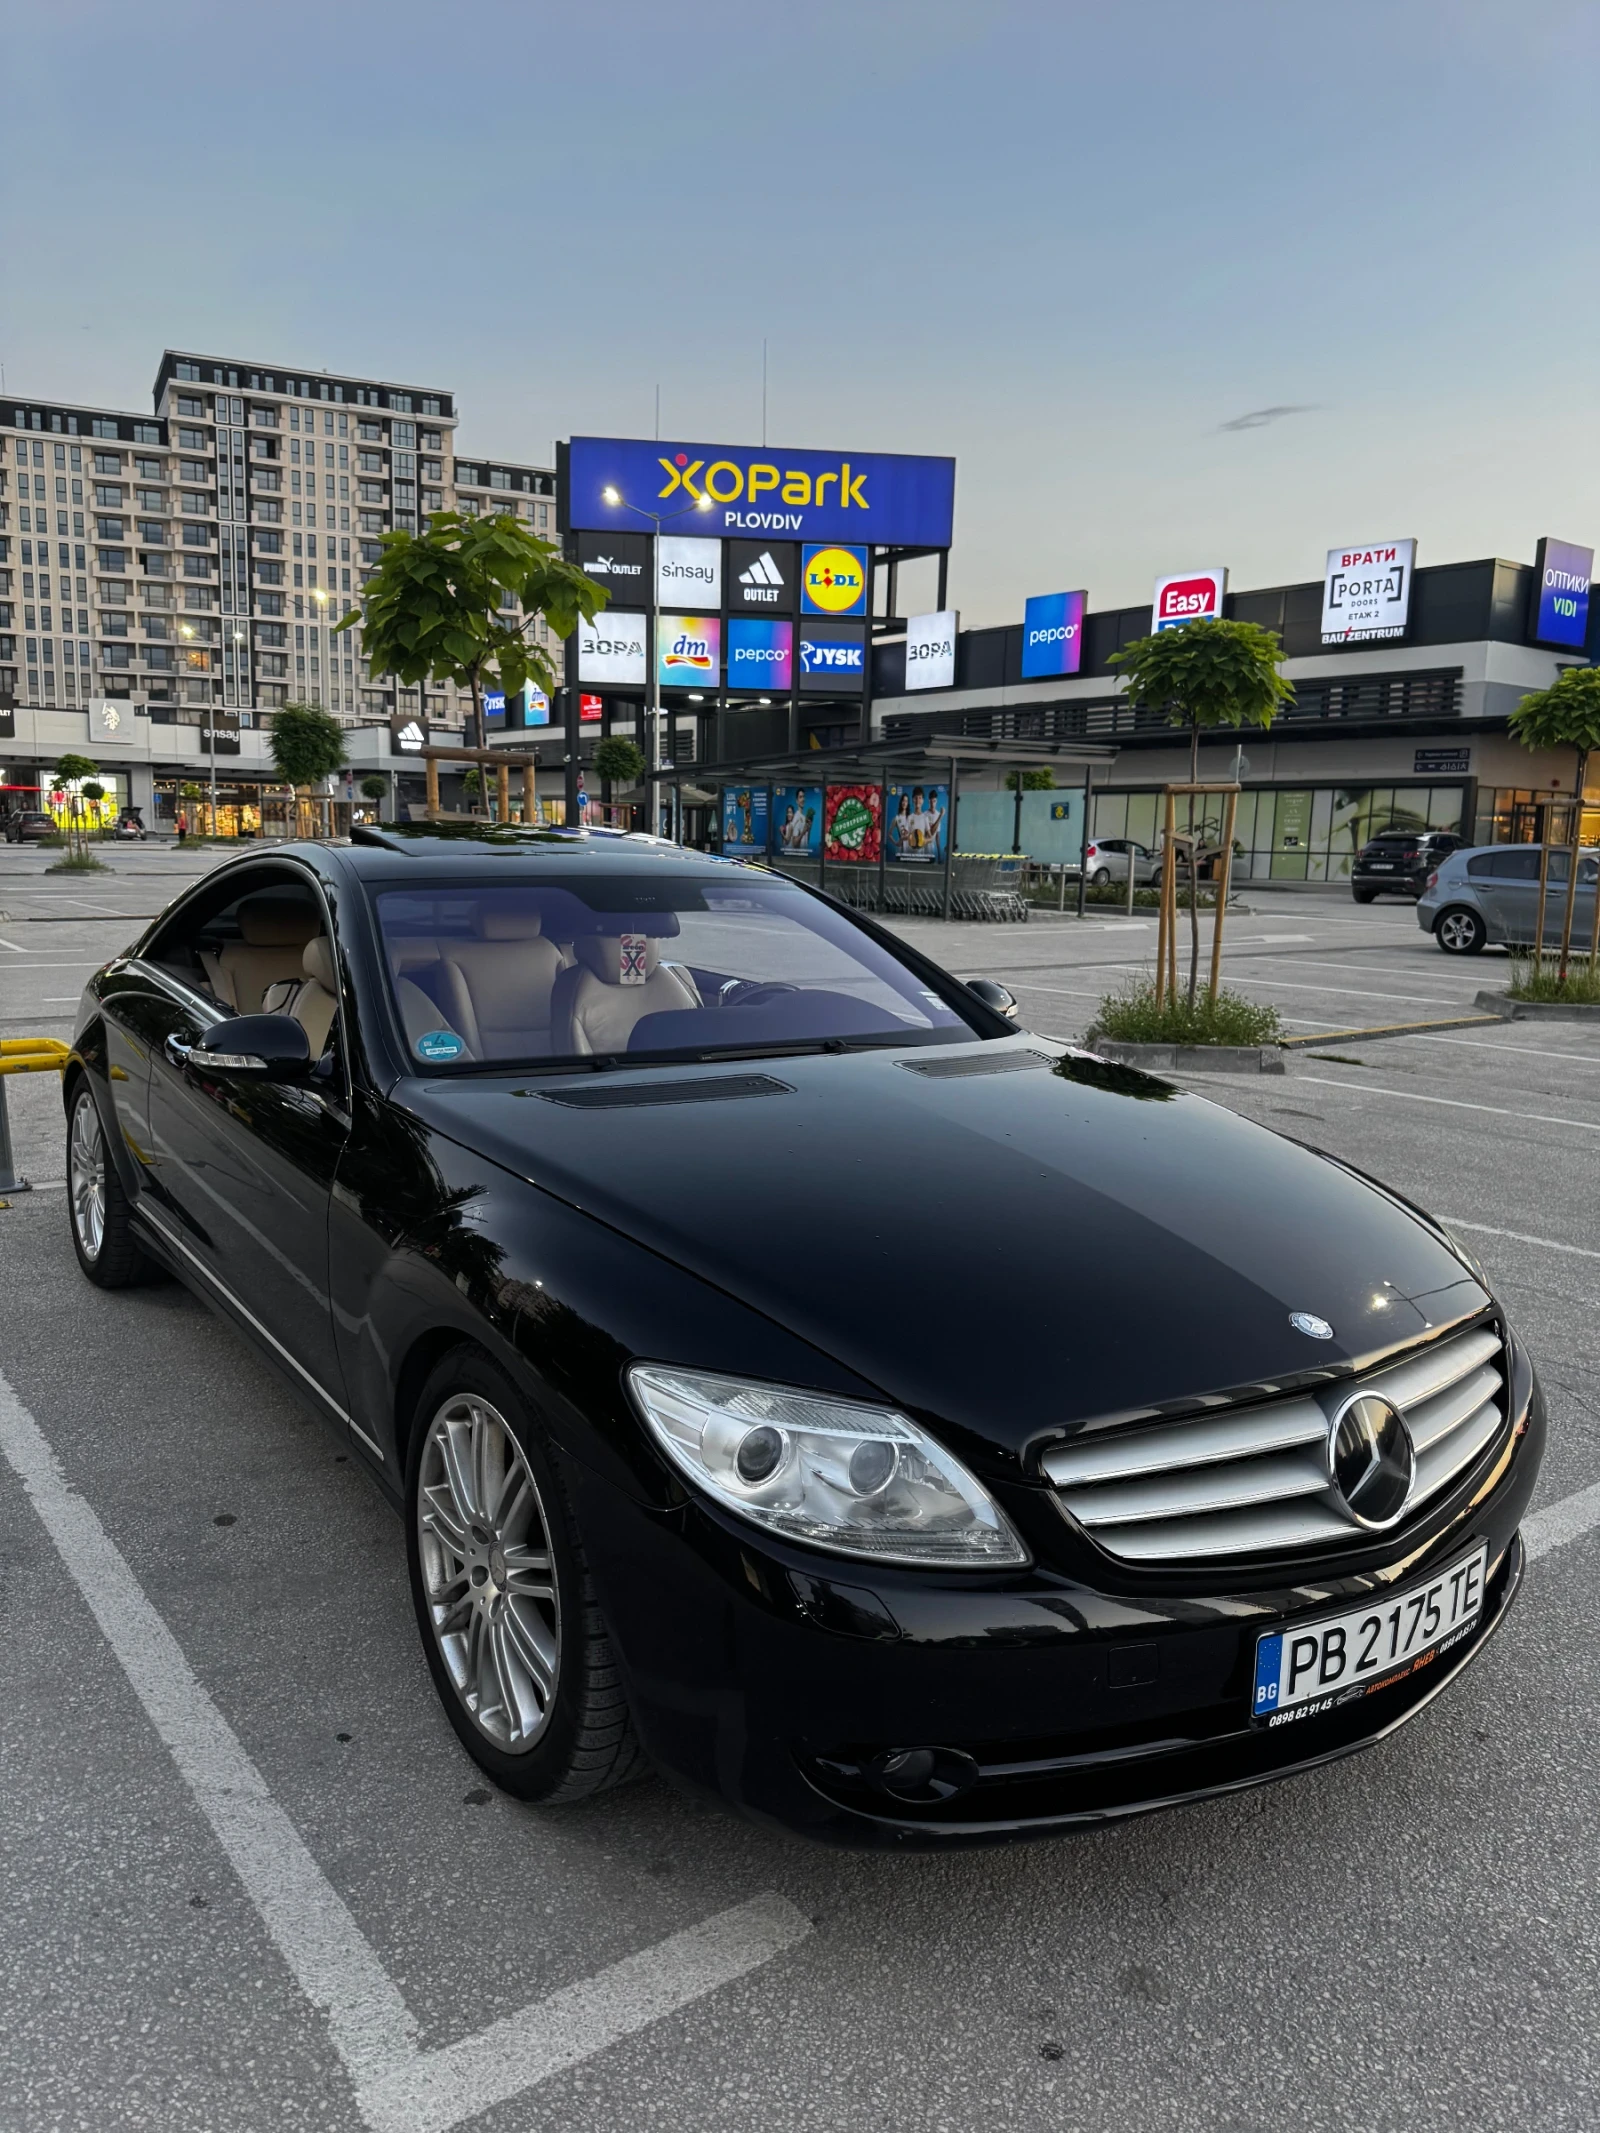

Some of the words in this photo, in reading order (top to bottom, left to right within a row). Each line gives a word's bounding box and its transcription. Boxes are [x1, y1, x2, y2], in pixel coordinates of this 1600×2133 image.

[658, 455, 870, 509] XOPark
[725, 511, 803, 530] PLOVDIV
[1341, 547, 1396, 567] ВРАТИ
[612, 564, 642, 575] OUTLET
[662, 562, 714, 583] sinsay
[809, 568, 859, 588] LIDL
[1339, 578, 1394, 598] PORTA
[1545, 568, 1589, 595] ОПТИКИ
[743, 588, 779, 602] OUTLET
[1165, 591, 1210, 613] Easy
[1351, 599, 1378, 607] DOORS
[1348, 611, 1372, 620] ЕТАЖ
[1553, 596, 1577, 618] VIDI
[673, 636, 705, 655] dm
[1030, 626, 1075, 646] pepco
[735, 648, 784, 663] pepco
[812, 648, 861, 666] JYSK
[203, 728, 239, 742] snsay
[622, 951, 643, 976] X
[1287, 1627, 1347, 1696] PB
[1355, 1583, 1443, 1674] 2175
[1450, 1555, 1482, 1623] TE
[1257, 1683, 1277, 1703] BG
[1269, 1711, 1294, 1727] 0898
[1295, 1708, 1307, 1719] 82
[1309, 1704, 1319, 1715] 91
[1320, 1698, 1333, 1710] 45
